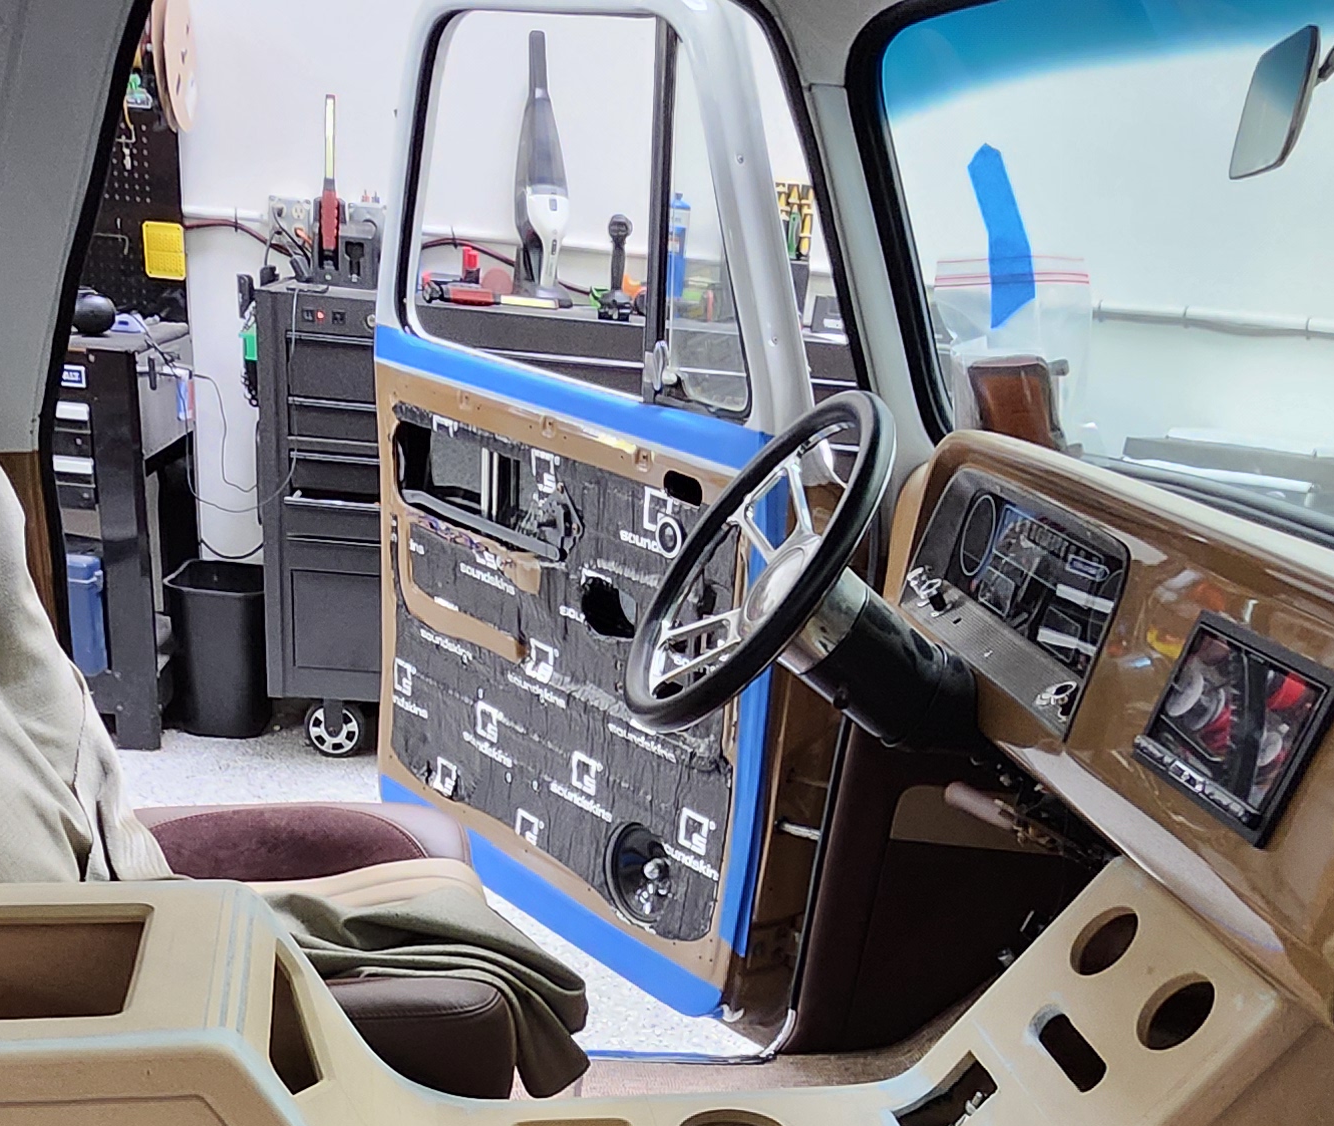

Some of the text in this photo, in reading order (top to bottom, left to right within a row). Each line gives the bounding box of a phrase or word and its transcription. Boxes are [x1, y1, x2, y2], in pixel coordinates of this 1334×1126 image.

[460, 562, 515, 595] soundskins
[608, 723, 677, 764] soundskins
[549, 781, 613, 823] soundskins
